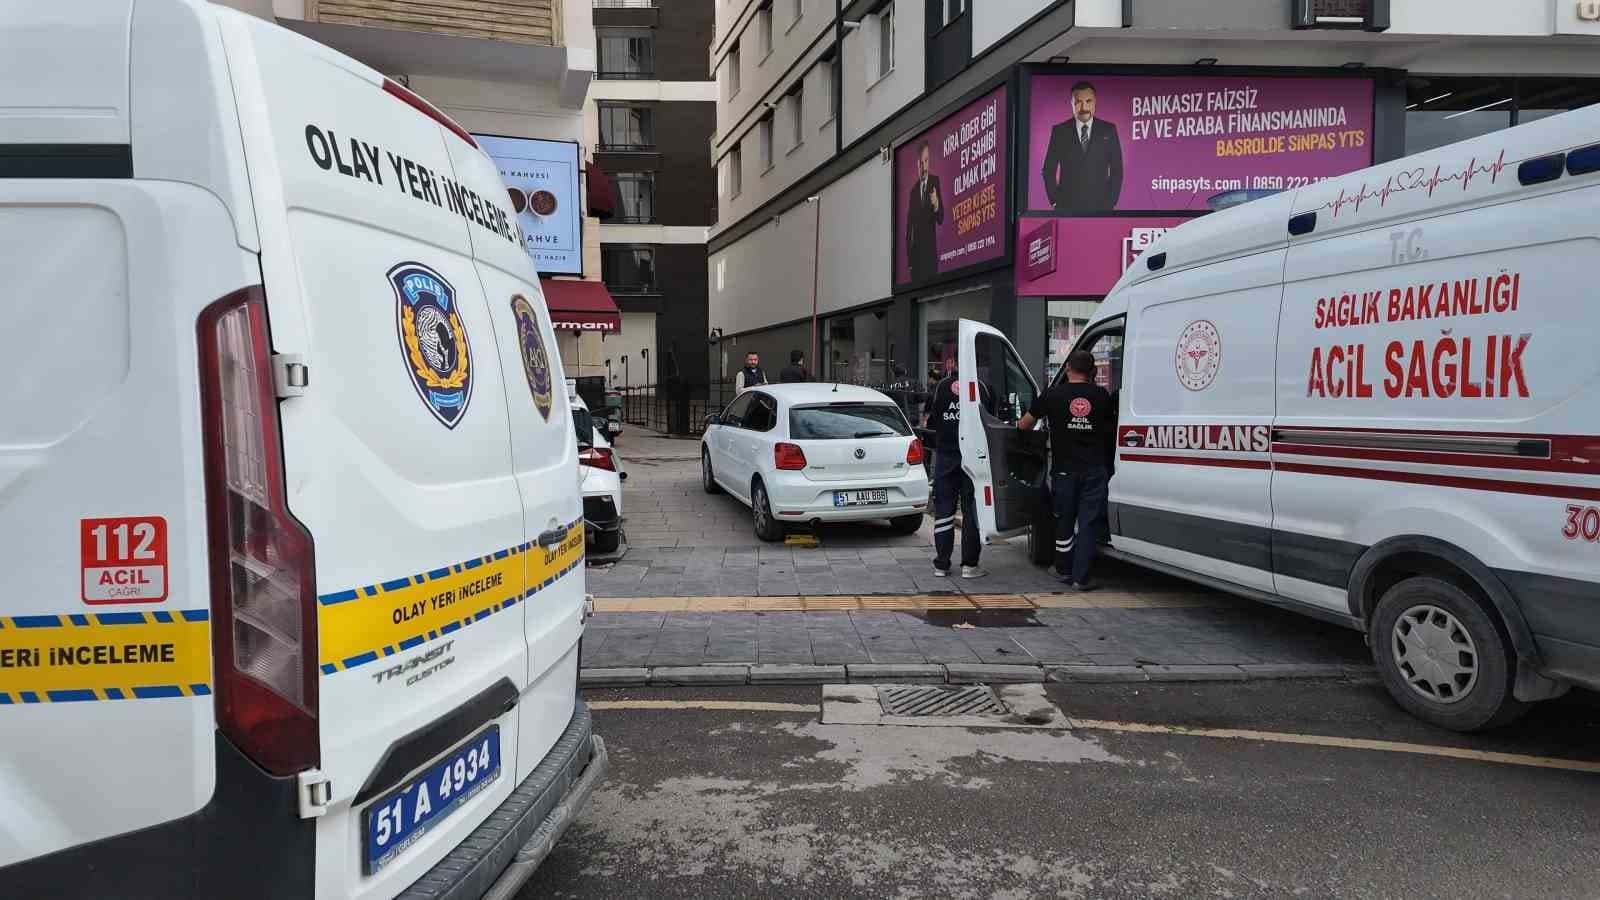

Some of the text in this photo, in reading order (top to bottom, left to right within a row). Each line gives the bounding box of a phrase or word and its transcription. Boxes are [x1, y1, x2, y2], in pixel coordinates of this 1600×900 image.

[1132, 86, 1258, 117] BANKASIZ FAİZSİZ
[1132, 107, 1346, 140] EV VE ARABA FİNANSMANINDA
[1338, 130, 1365, 148] YTS
[305, 124, 383, 185] OLAY
[954, 166, 978, 195] OLMAK
[1151, 175, 1241, 193] sinpasyts.com
[1253, 176, 1283, 190] 0850
[526, 234, 559, 244] AHVE
[551, 321, 614, 330] rmani
[1383, 328, 1532, 398] SAĞLIK
[1144, 426, 1269, 451] AMBULANS
[1561, 504, 1600, 543] 30
[91, 522, 155, 560] 112
[392, 600, 427, 624] OLAY
[372, 640, 455, 683] TRANSIT
[406, 656, 455, 687] CUSTOM
[376, 798, 402, 846] 51
[414, 782, 432, 823] A
[439, 740, 490, 799] 4934
